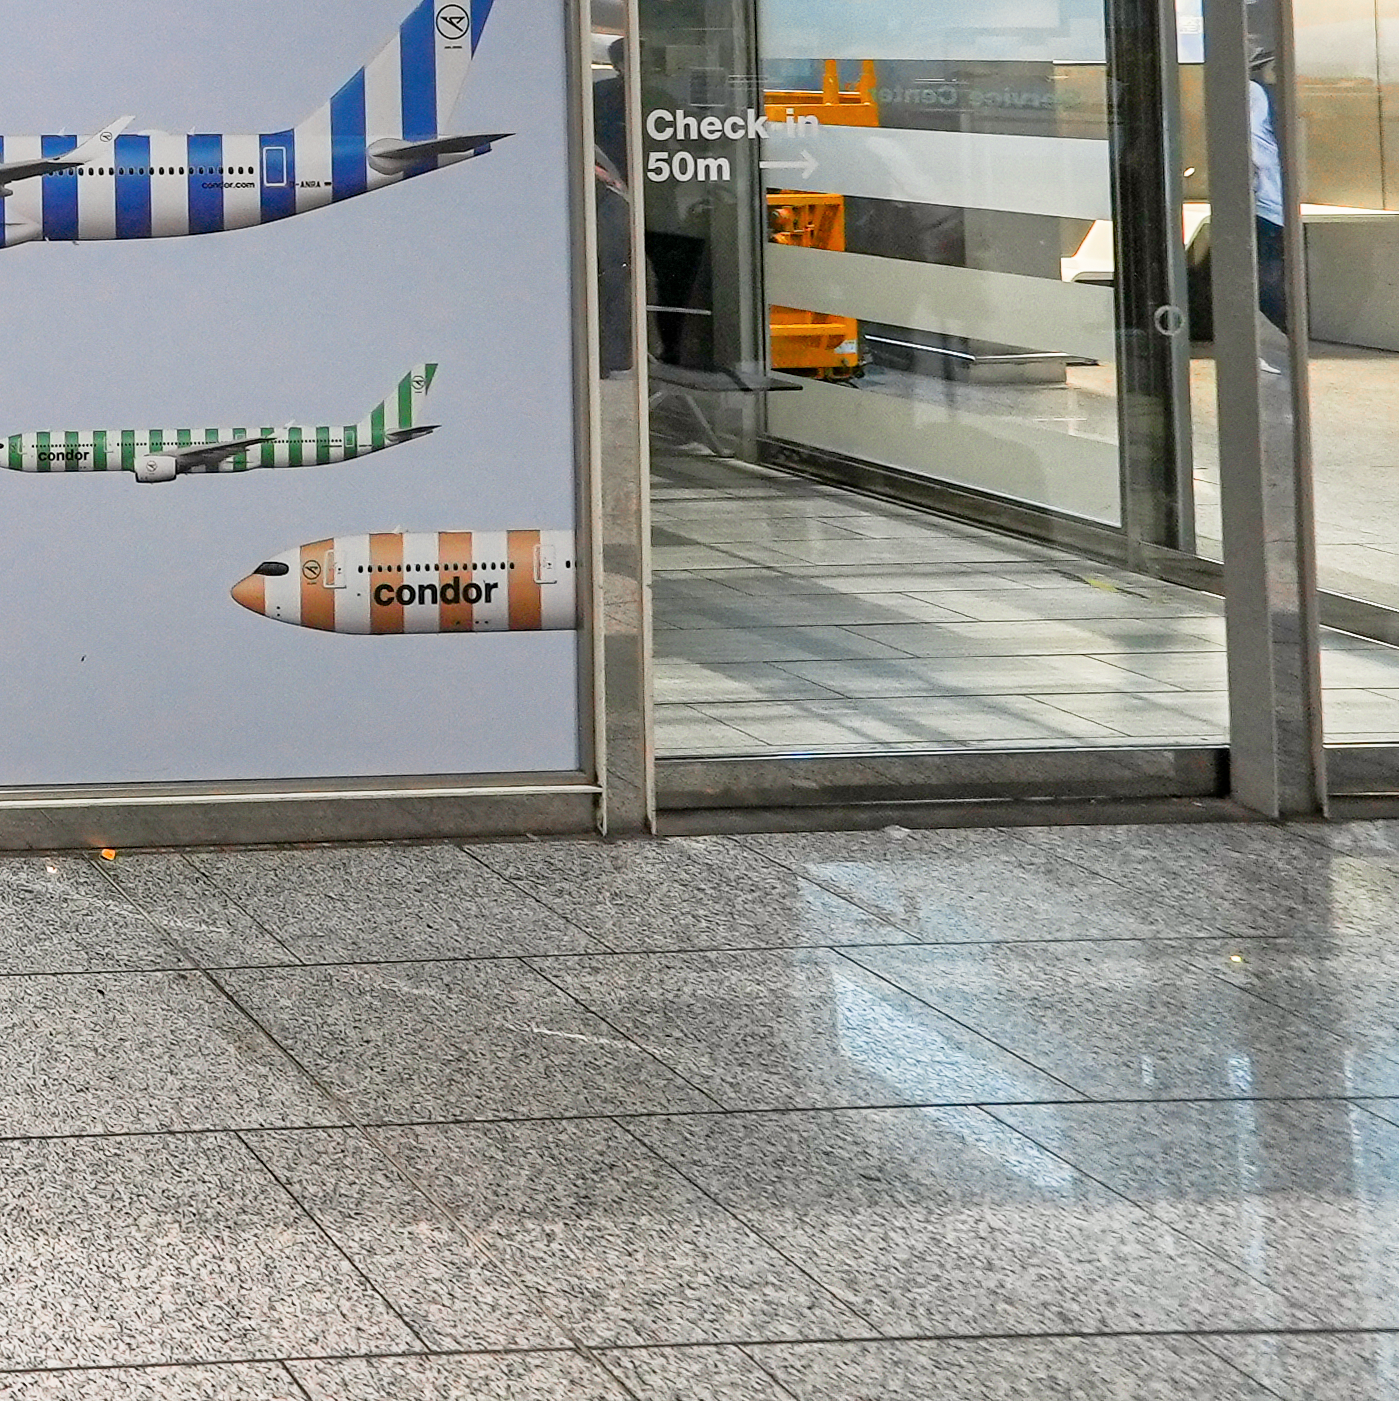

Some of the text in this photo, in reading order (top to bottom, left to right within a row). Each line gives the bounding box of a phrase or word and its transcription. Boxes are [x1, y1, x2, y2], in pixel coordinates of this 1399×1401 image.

[647, 151, 731, 182] 50m
[38, 449, 90, 461] condor
[374, 576, 499, 607] condor
